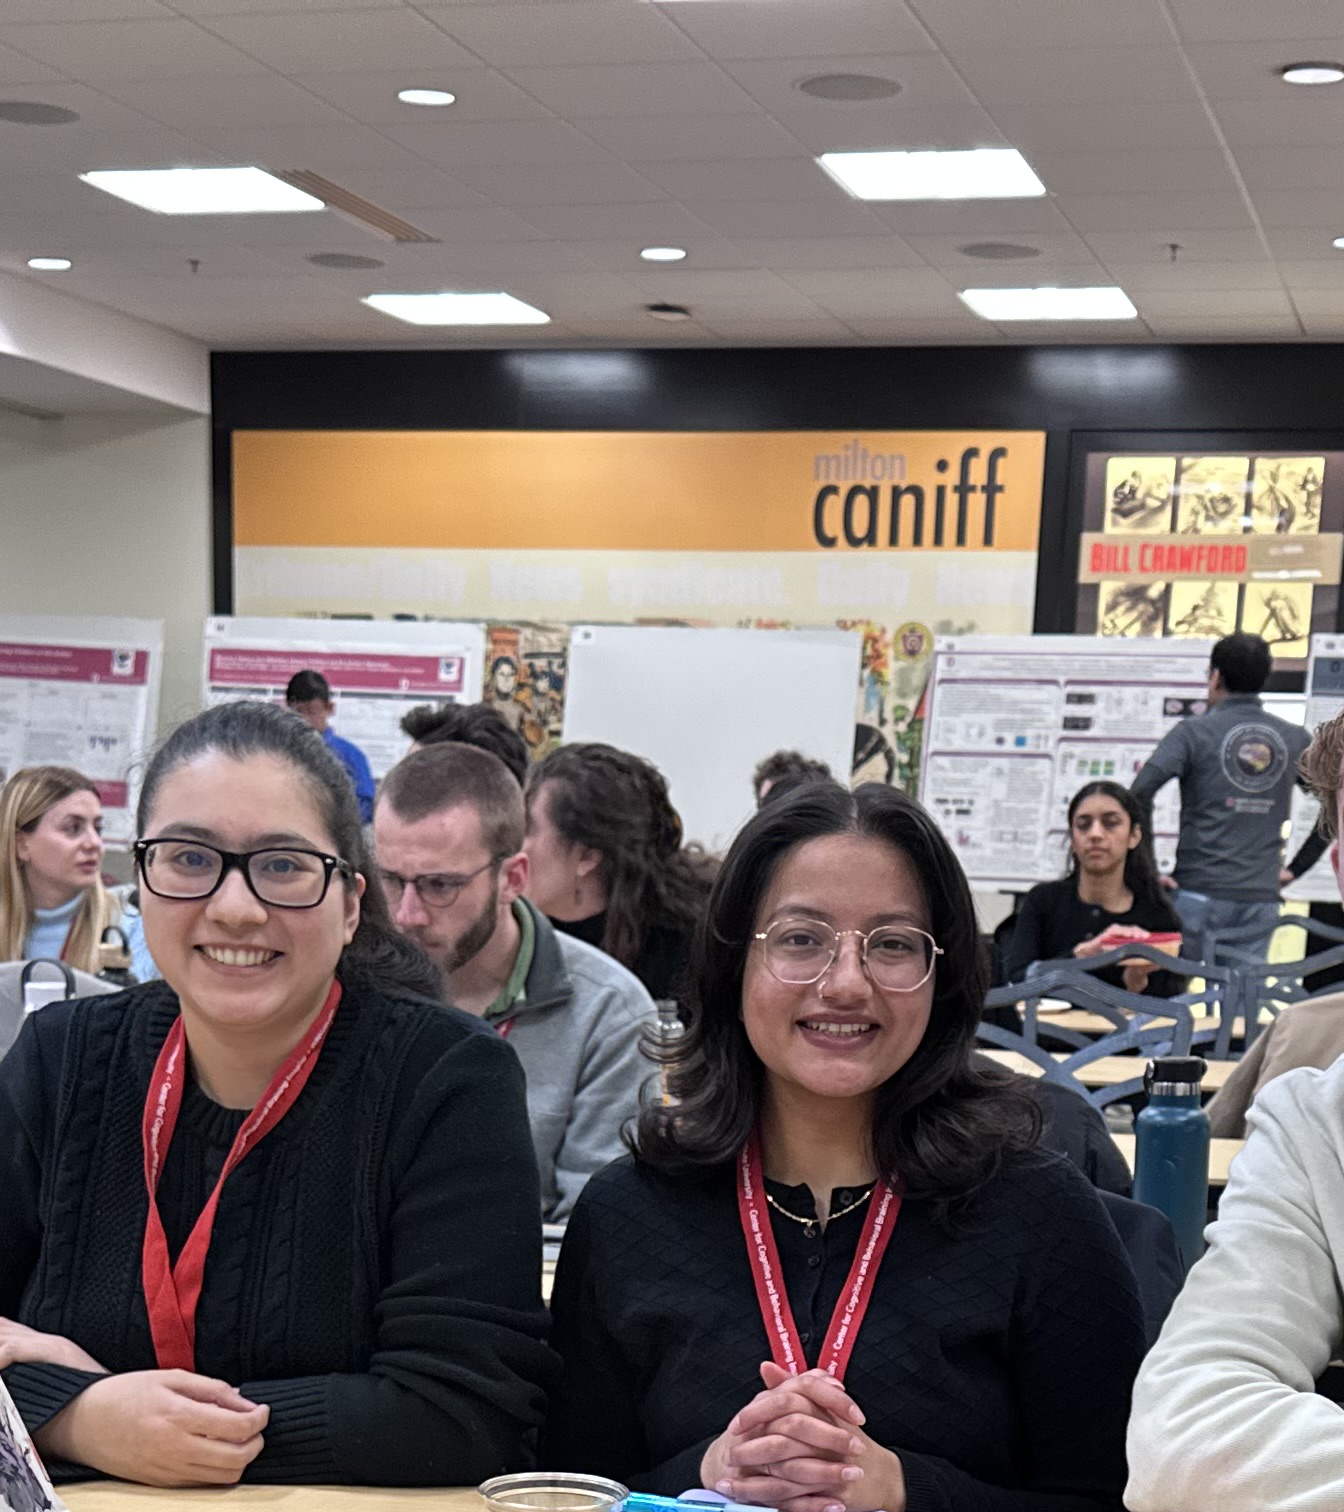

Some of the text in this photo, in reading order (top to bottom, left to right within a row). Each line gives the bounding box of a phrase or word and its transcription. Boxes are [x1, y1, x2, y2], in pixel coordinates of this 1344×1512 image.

[814, 439, 906, 482] milton
[813, 447, 1008, 549] caniff
[1090, 543, 1248, 574] BILL CRAWFORD
[748, 1208, 760, 1232] Center
[753, 1231, 762, 1244] for
[756, 1244, 771, 1279] Cognitive
[859, 1260, 869, 1275] and
[765, 1279, 776, 1294] and
[844, 1274, 865, 1313] Cognitive
[840, 1312, 852, 1325] for
[831, 1324, 848, 1350] Center
